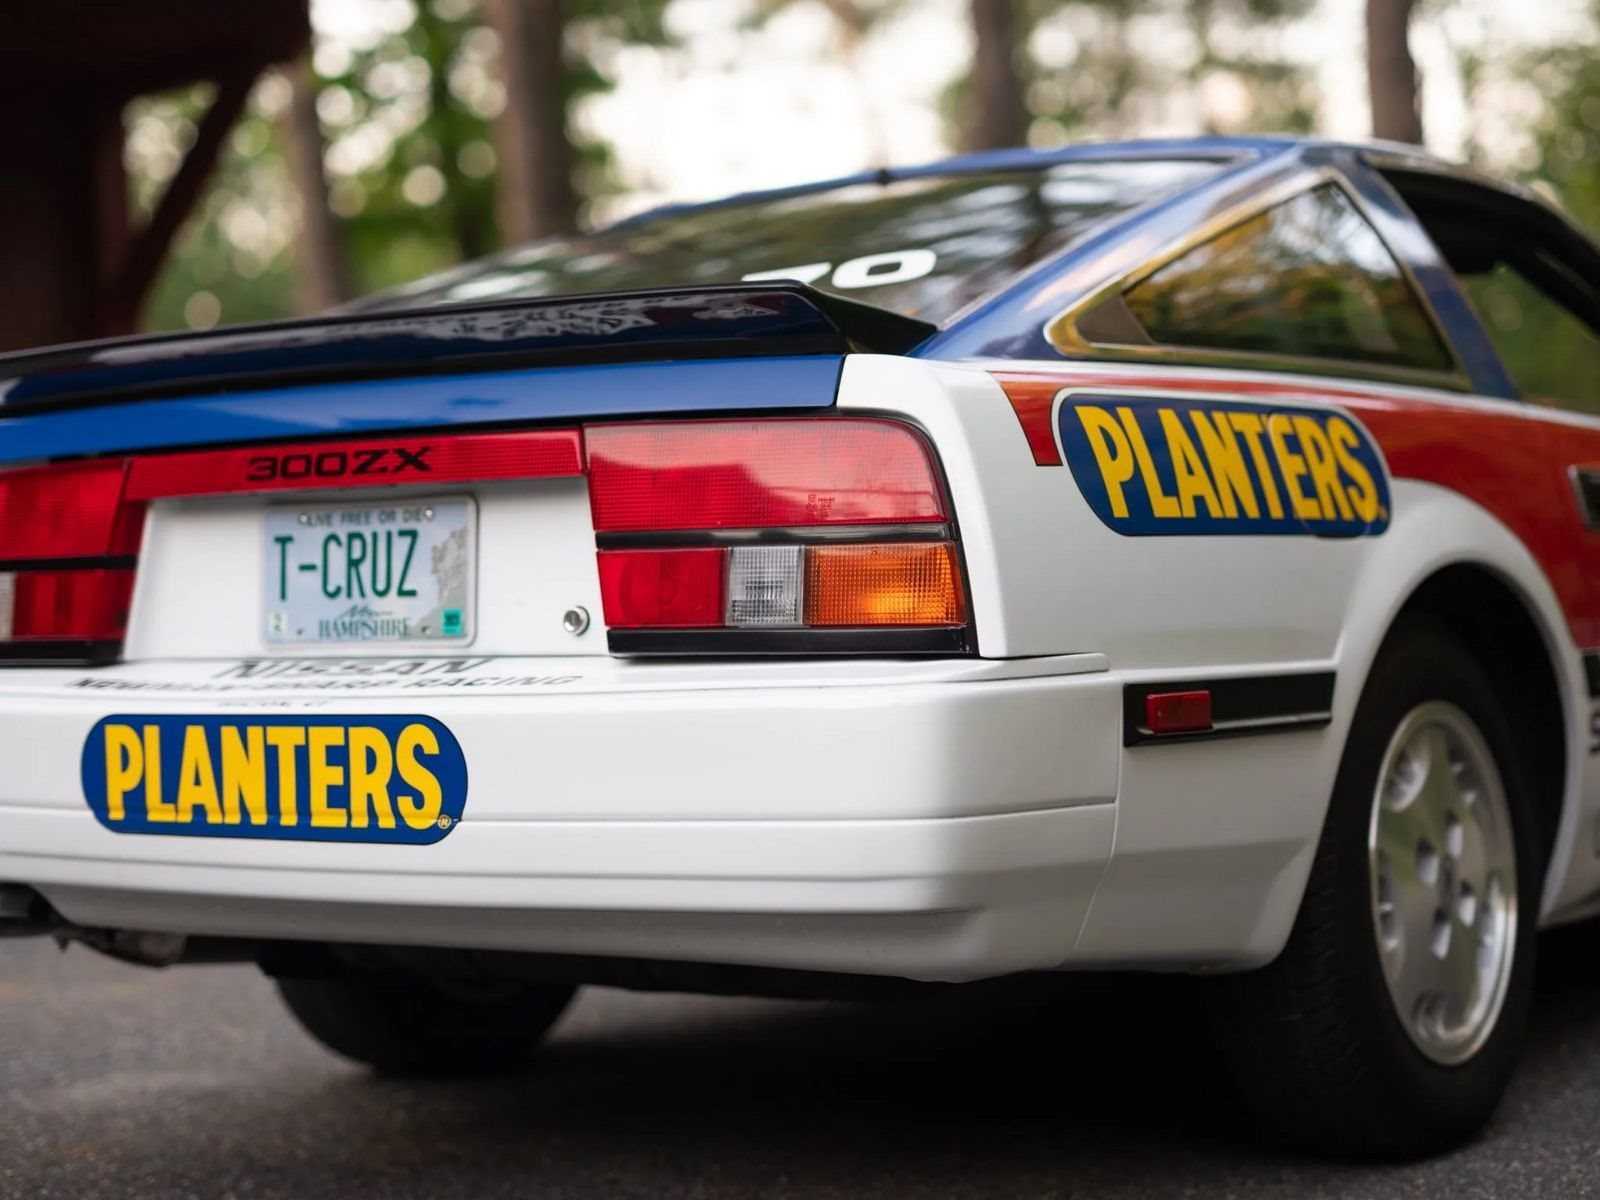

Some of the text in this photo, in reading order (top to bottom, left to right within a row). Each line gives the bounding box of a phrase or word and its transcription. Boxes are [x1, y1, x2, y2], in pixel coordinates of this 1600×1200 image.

[246, 446, 432, 481] 300ZX
[1074, 405, 1380, 523] PLANTERS
[340, 510, 371, 526] FREE
[378, 508, 396, 524] OR
[274, 529, 419, 602] T-CRUZ
[319, 617, 412, 640] HAMPSHIRE
[212, 657, 493, 679] NISSAN
[403, 675, 584, 689] RACING
[104, 723, 443, 830] PLANTERS
